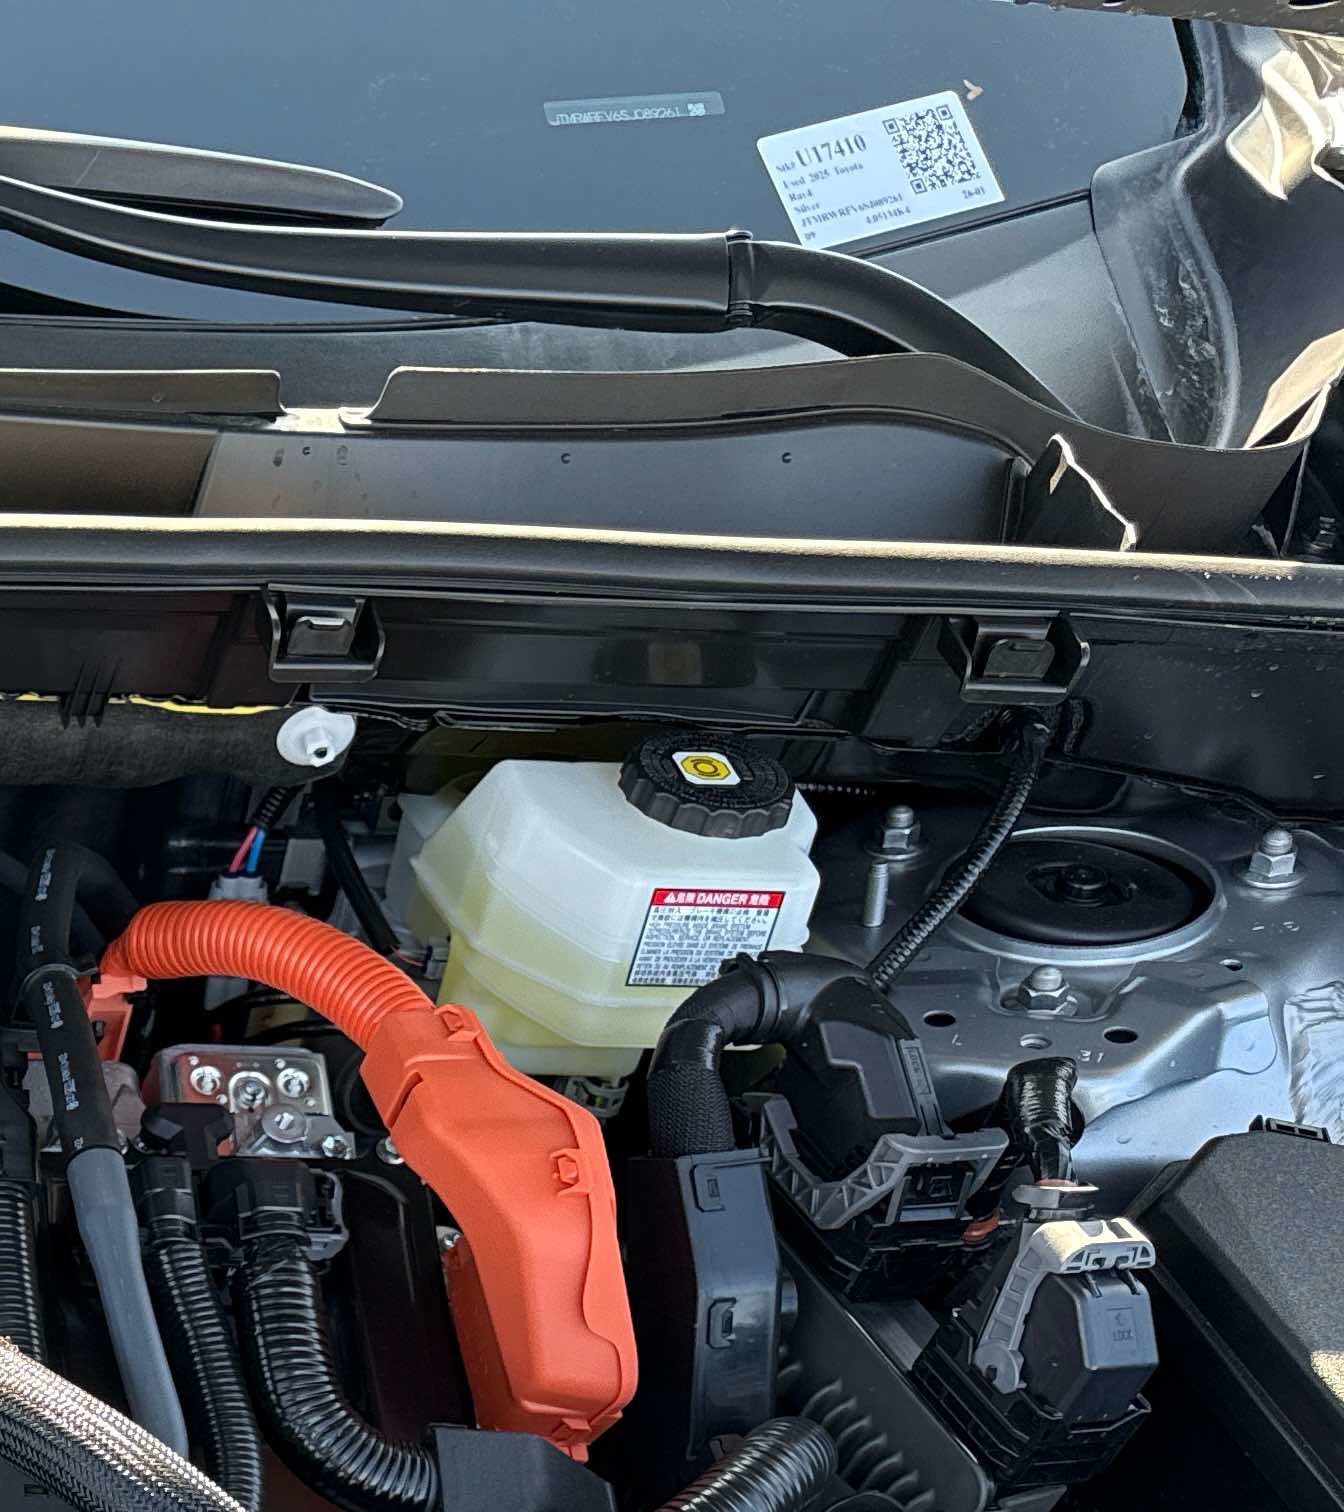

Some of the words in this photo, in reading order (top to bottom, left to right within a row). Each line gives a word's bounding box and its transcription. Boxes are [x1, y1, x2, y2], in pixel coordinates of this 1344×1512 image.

[795, 134, 867, 167] U17410
[834, 163, 864, 176] Toyota
[695, 892, 749, 906] DANGER
